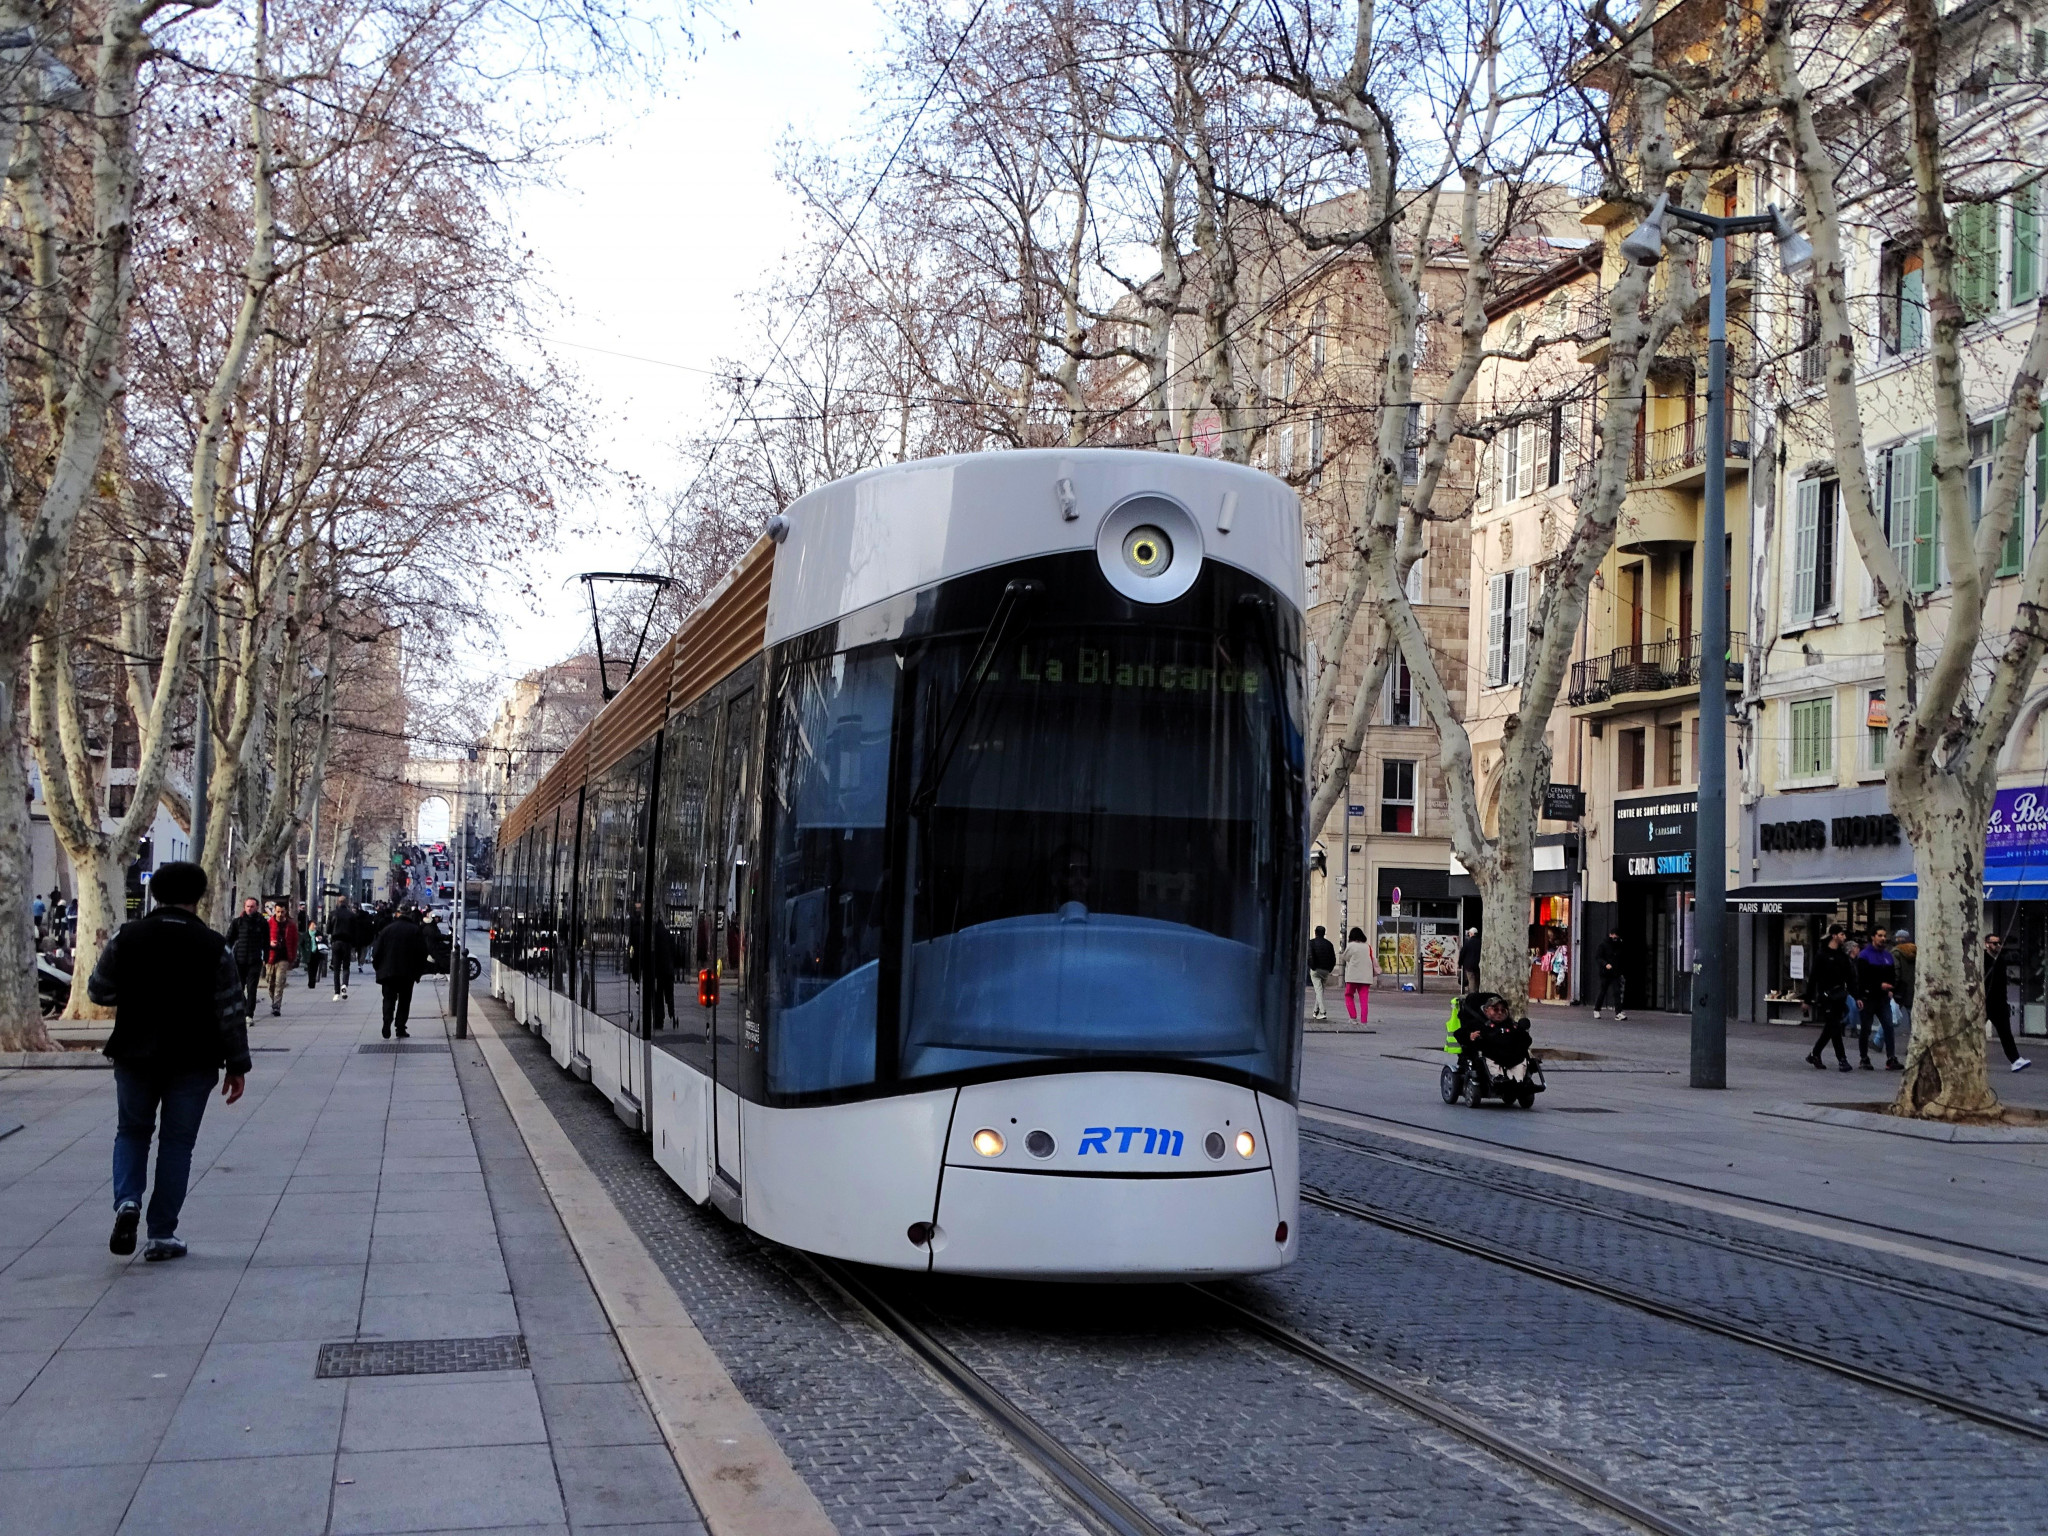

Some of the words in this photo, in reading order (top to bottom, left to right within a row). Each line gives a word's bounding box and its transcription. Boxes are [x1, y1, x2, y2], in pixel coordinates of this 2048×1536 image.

[1020, 645, 1063, 683] La
[1617, 808, 1635, 819] CENTRE
[1636, 806, 1642, 817] DE
[1643, 804, 1660, 817] SANTÉ
[1660, 803, 1682, 815] MÉDICAL
[1683, 802, 1690, 812] ET
[1760, 819, 1827, 853] PARIS
[1831, 814, 1901, 848] MODE
[1628, 857, 1656, 876] CARA
[1657, 852, 1692, 874] SANTÉ
[1738, 903, 1758, 913] PARIS
[1762, 903, 1783, 913] MODE
[1078, 1126, 1184, 1157] RTM
